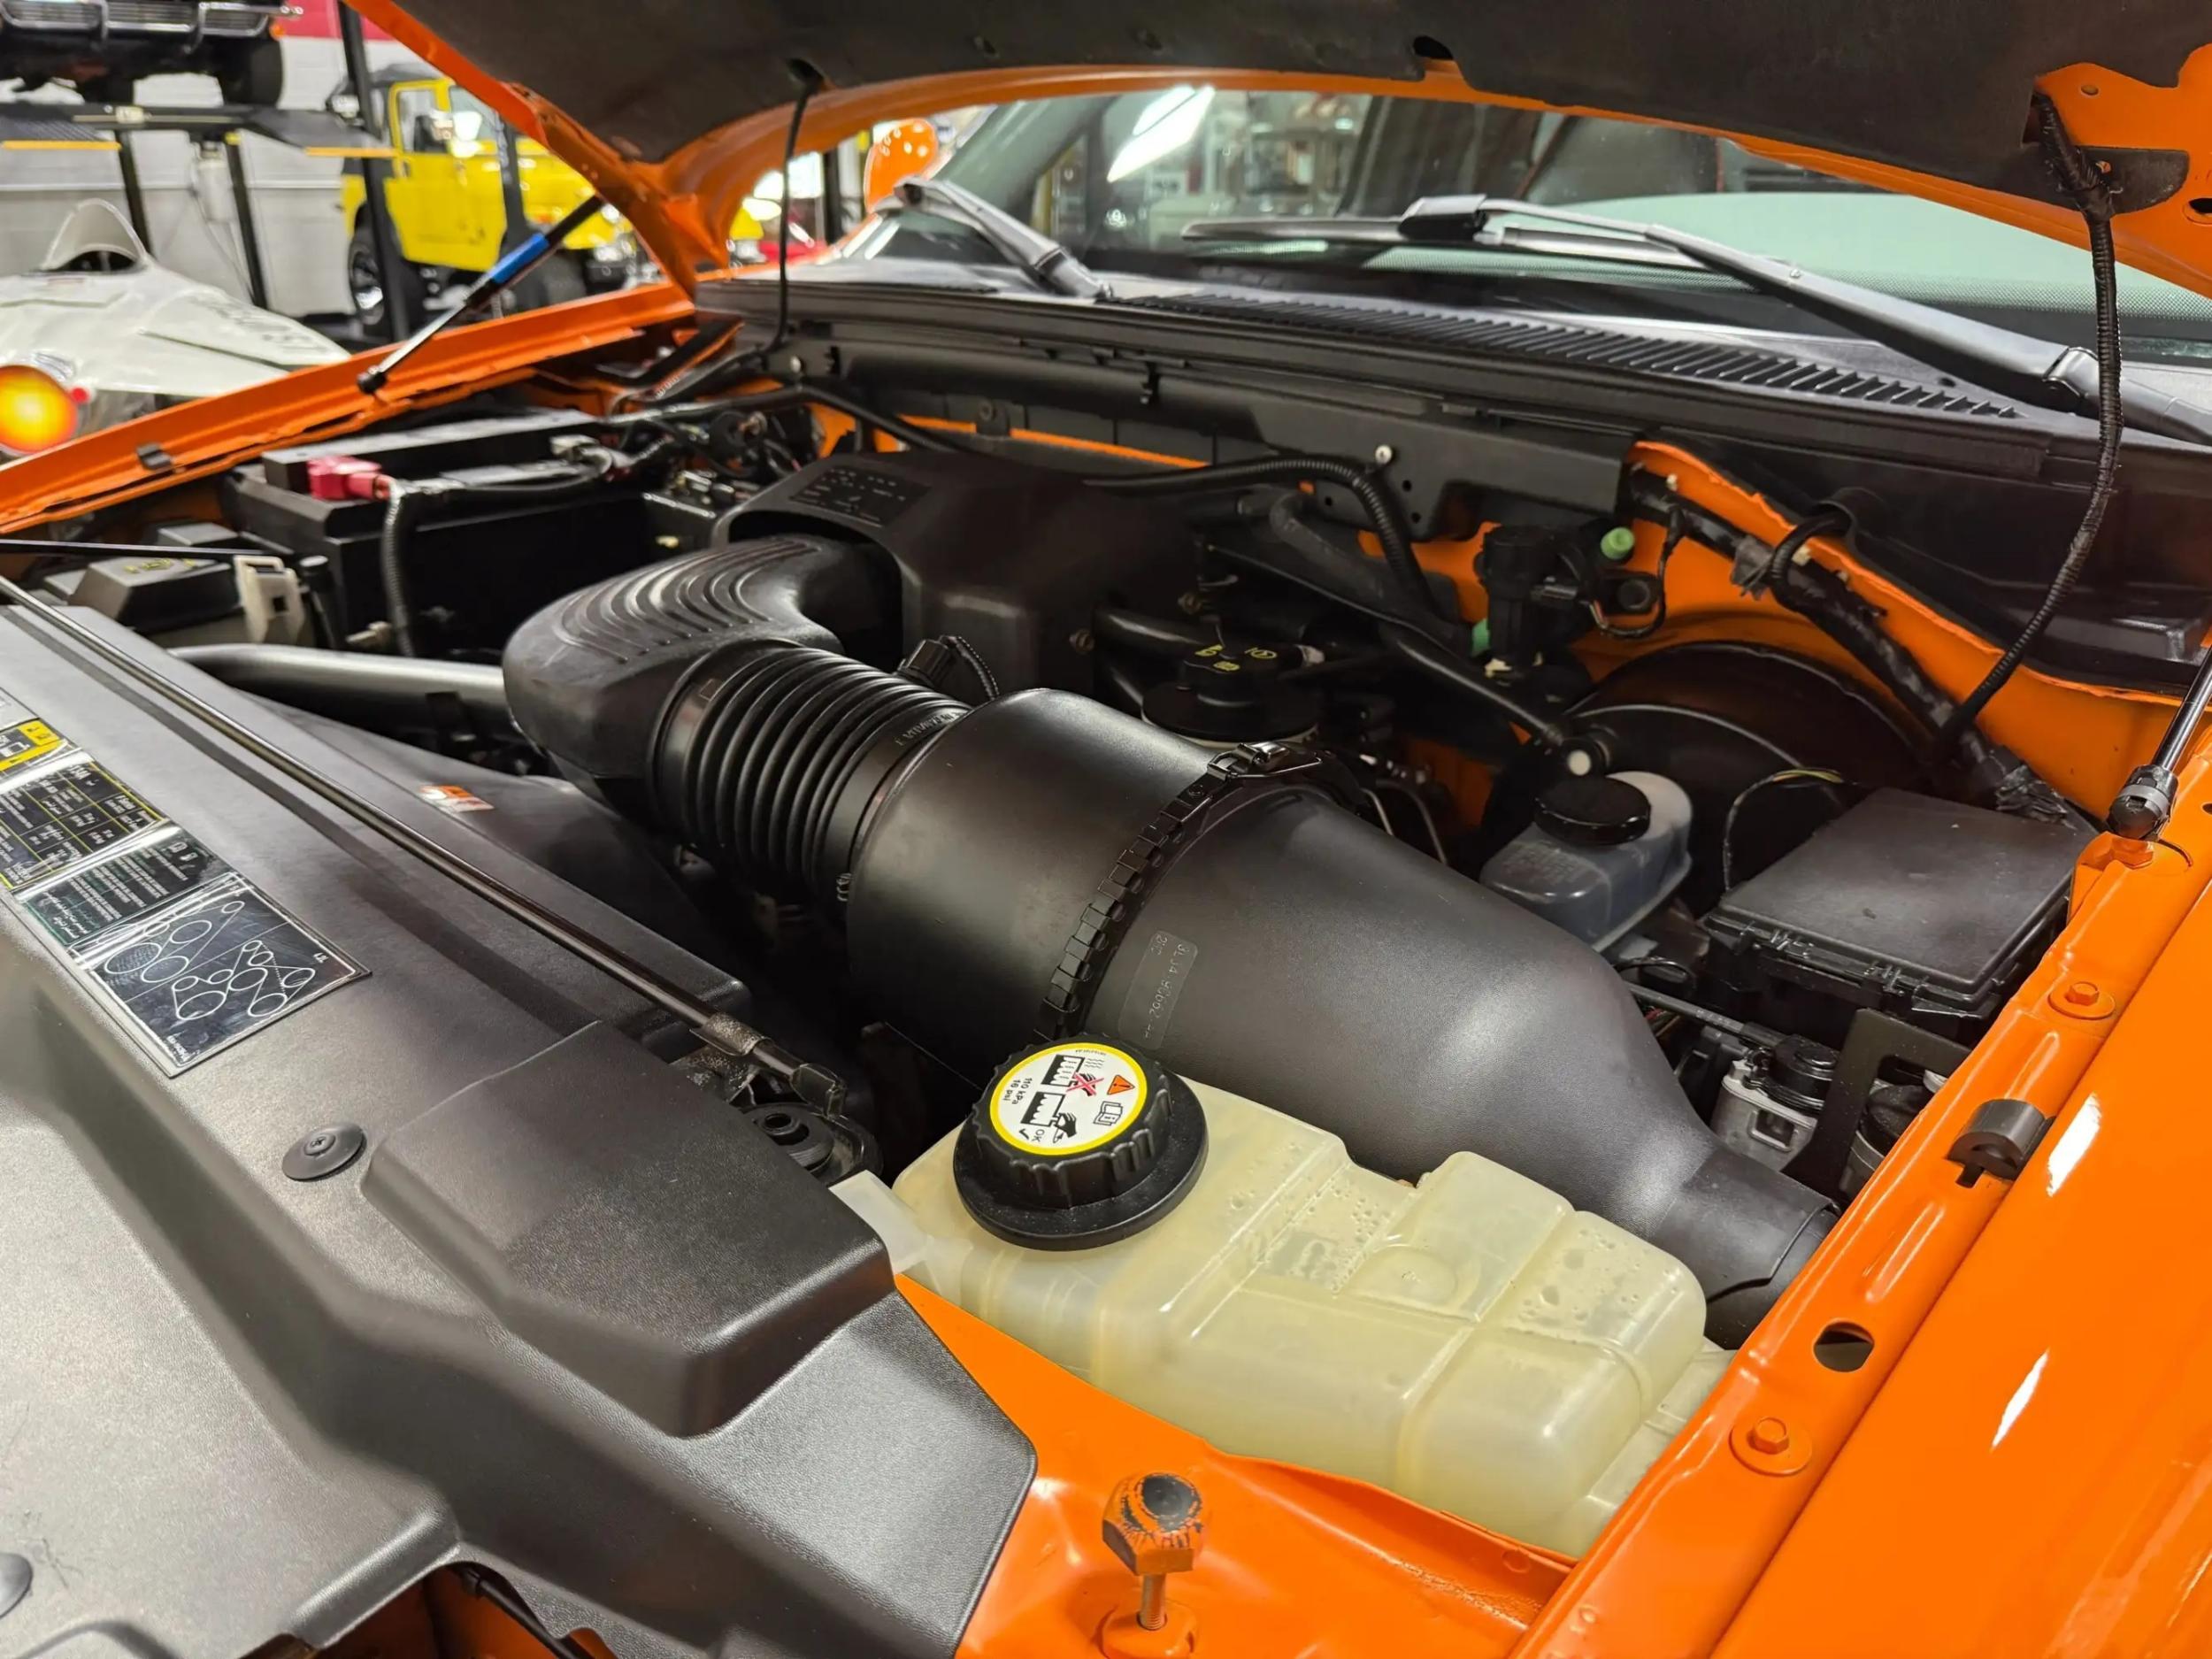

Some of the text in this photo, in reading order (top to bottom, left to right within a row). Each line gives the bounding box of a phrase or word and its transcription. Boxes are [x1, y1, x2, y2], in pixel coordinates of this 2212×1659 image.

[1002, 1079, 1021, 1102] 16 psi
[1011, 1078, 1033, 1105] 110 kPa
[1031, 1128, 1045, 1142] OK
